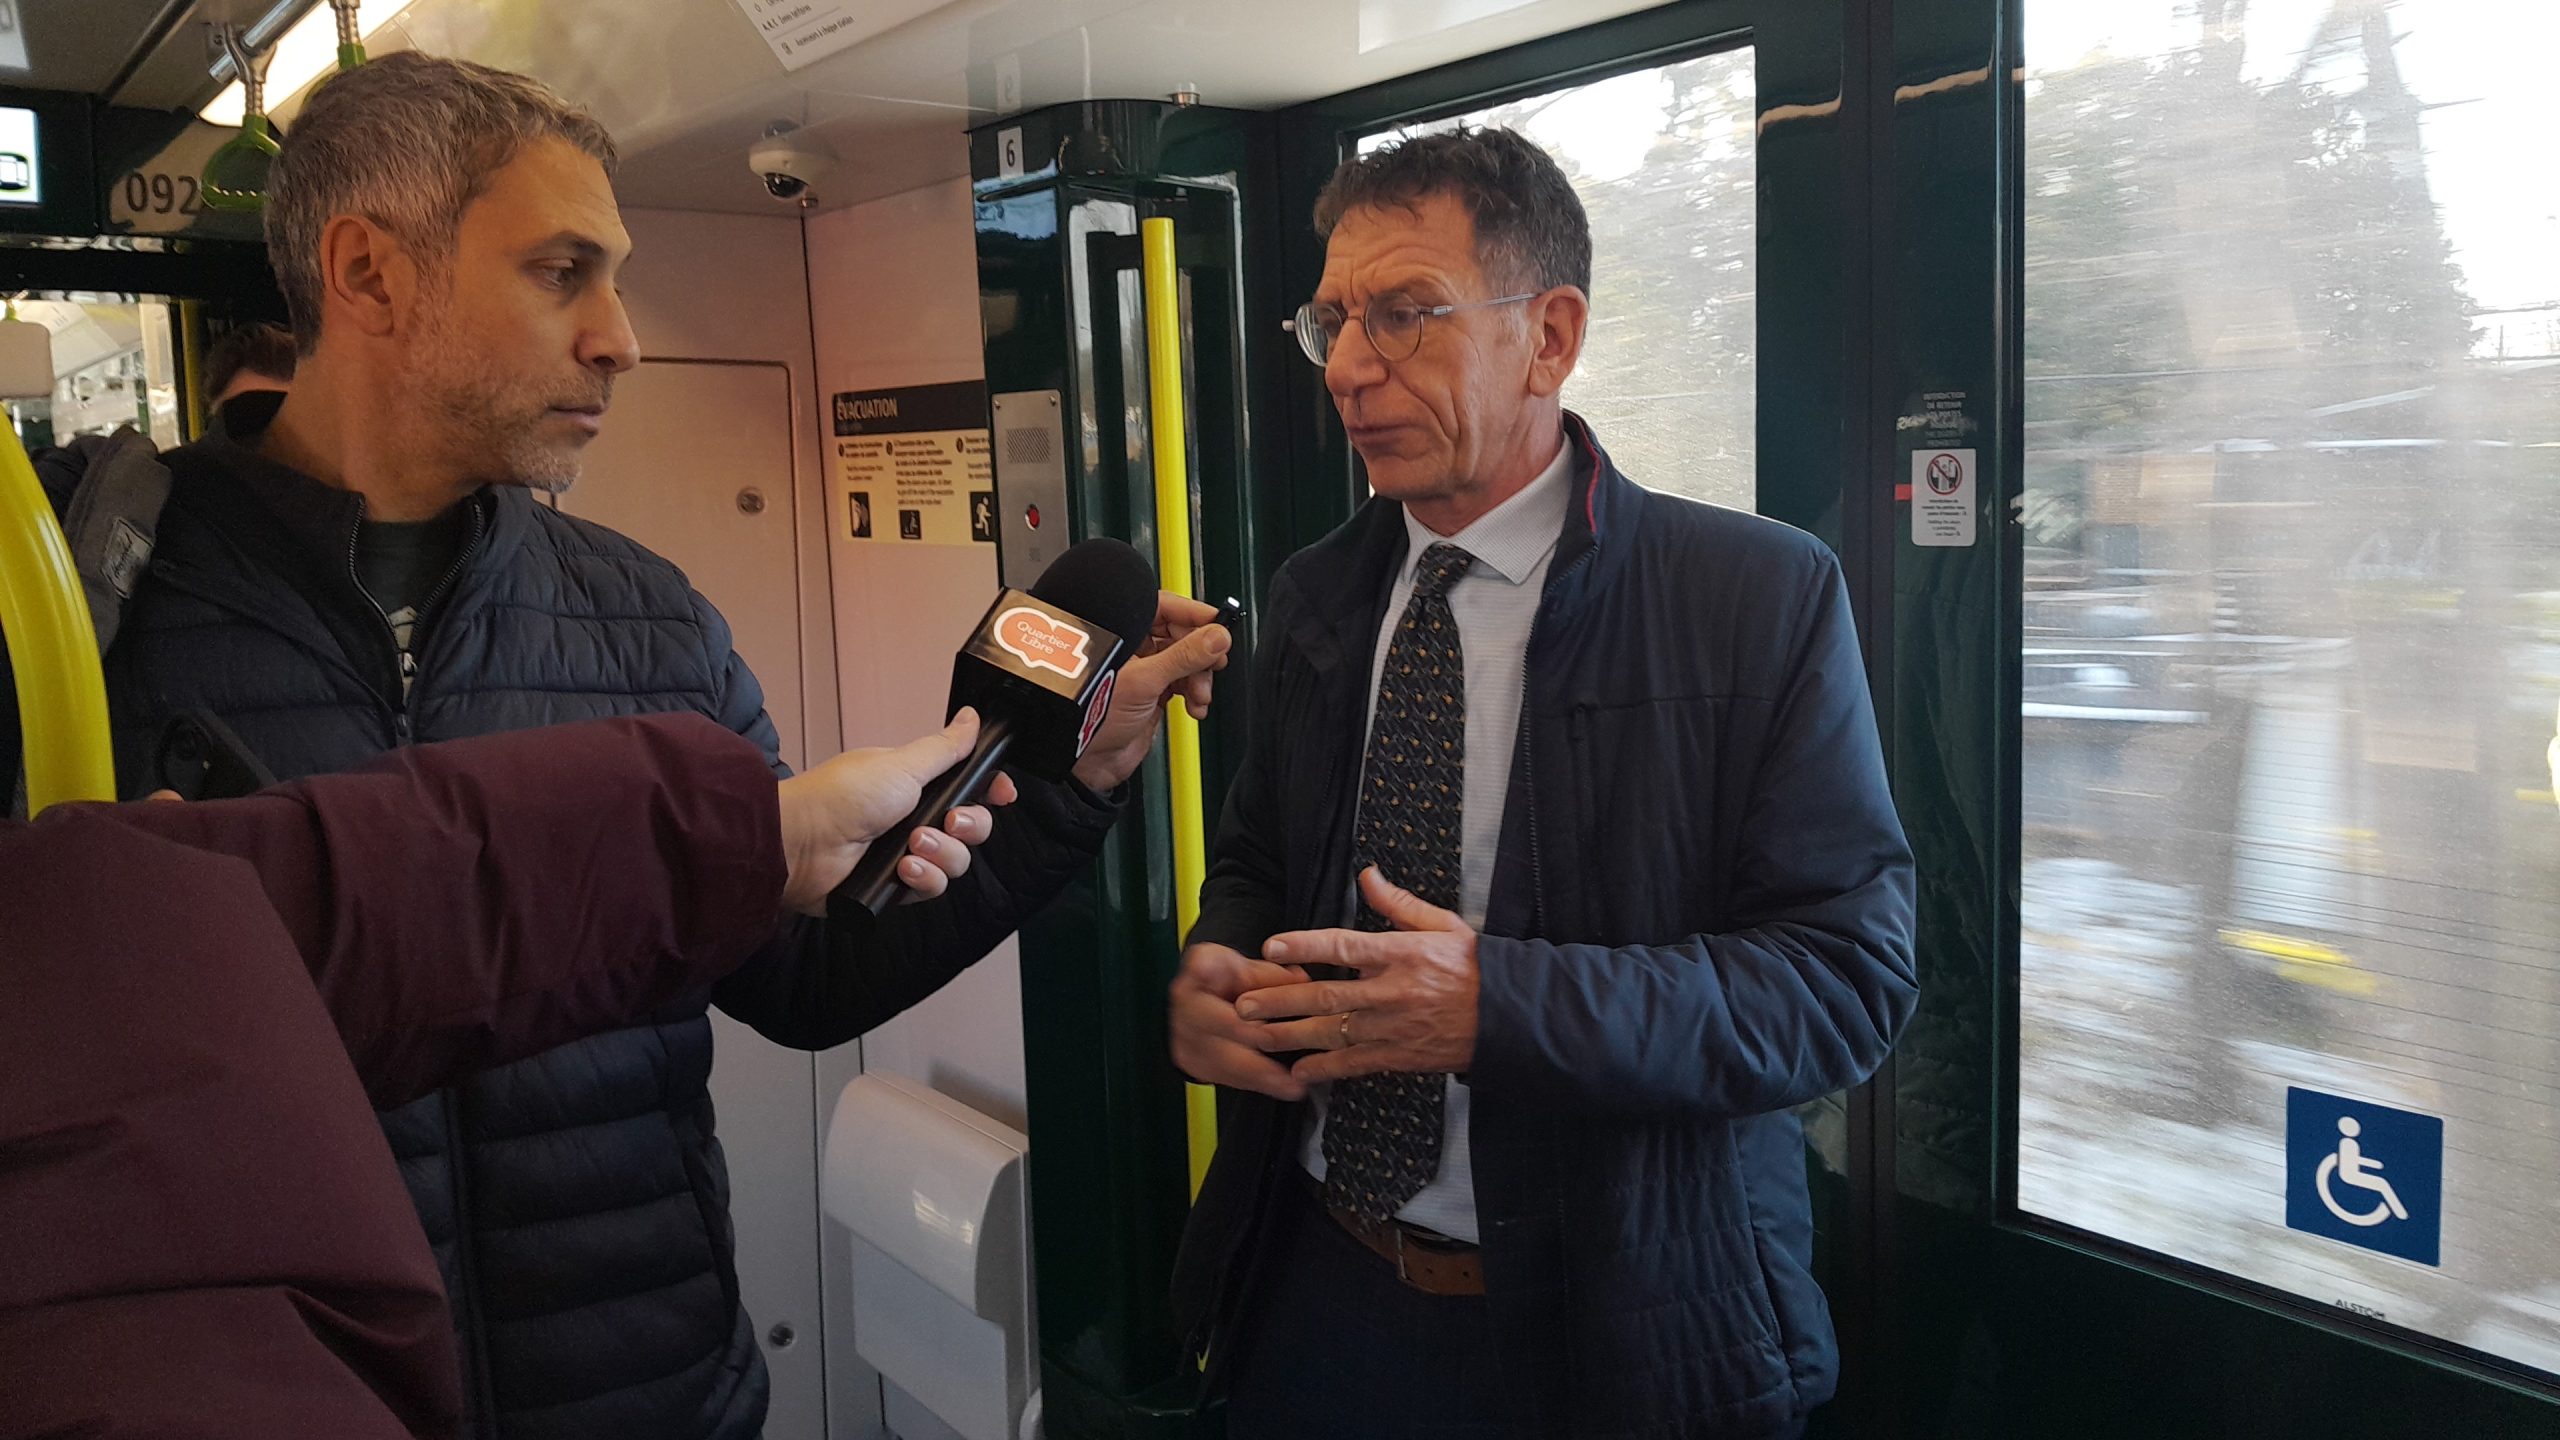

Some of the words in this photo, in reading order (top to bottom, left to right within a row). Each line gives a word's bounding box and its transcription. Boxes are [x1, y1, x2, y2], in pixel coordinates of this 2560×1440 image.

[1006, 139, 1015, 167] 6
[837, 396, 899, 421] ÉVACUATION
[1015, 620, 1073, 651] Quartier
[1020, 633, 1055, 655] Libre
[2335, 1299, 2386, 1320] ALSTOM
